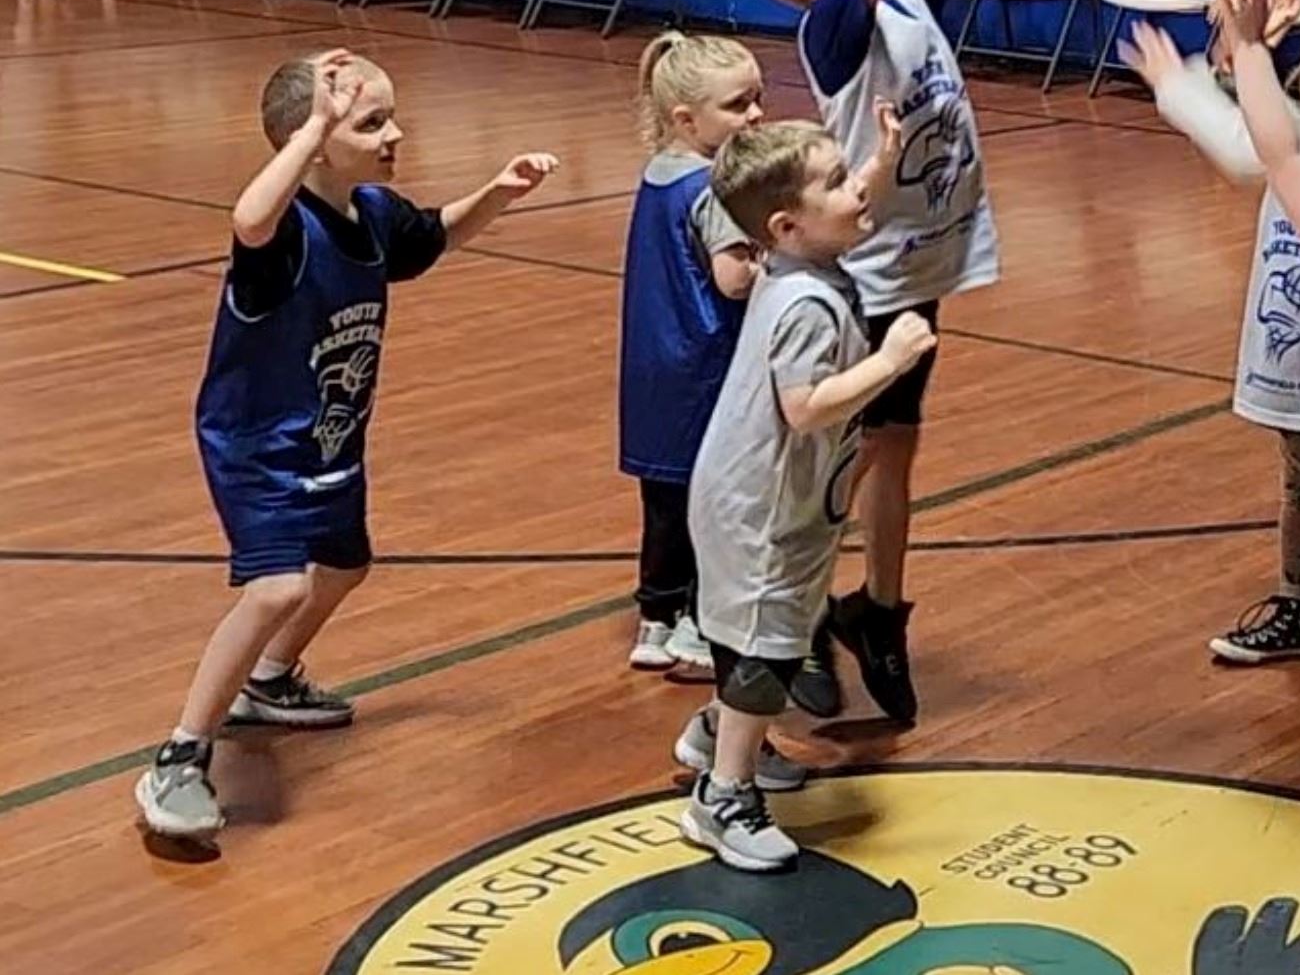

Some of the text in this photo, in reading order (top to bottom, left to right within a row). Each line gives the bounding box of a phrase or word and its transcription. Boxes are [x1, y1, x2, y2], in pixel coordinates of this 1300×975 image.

[940, 823, 1039, 874] STUDENT
[973, 834, 1071, 880] COUNCIL
[1007, 834, 1138, 898] 88-89
